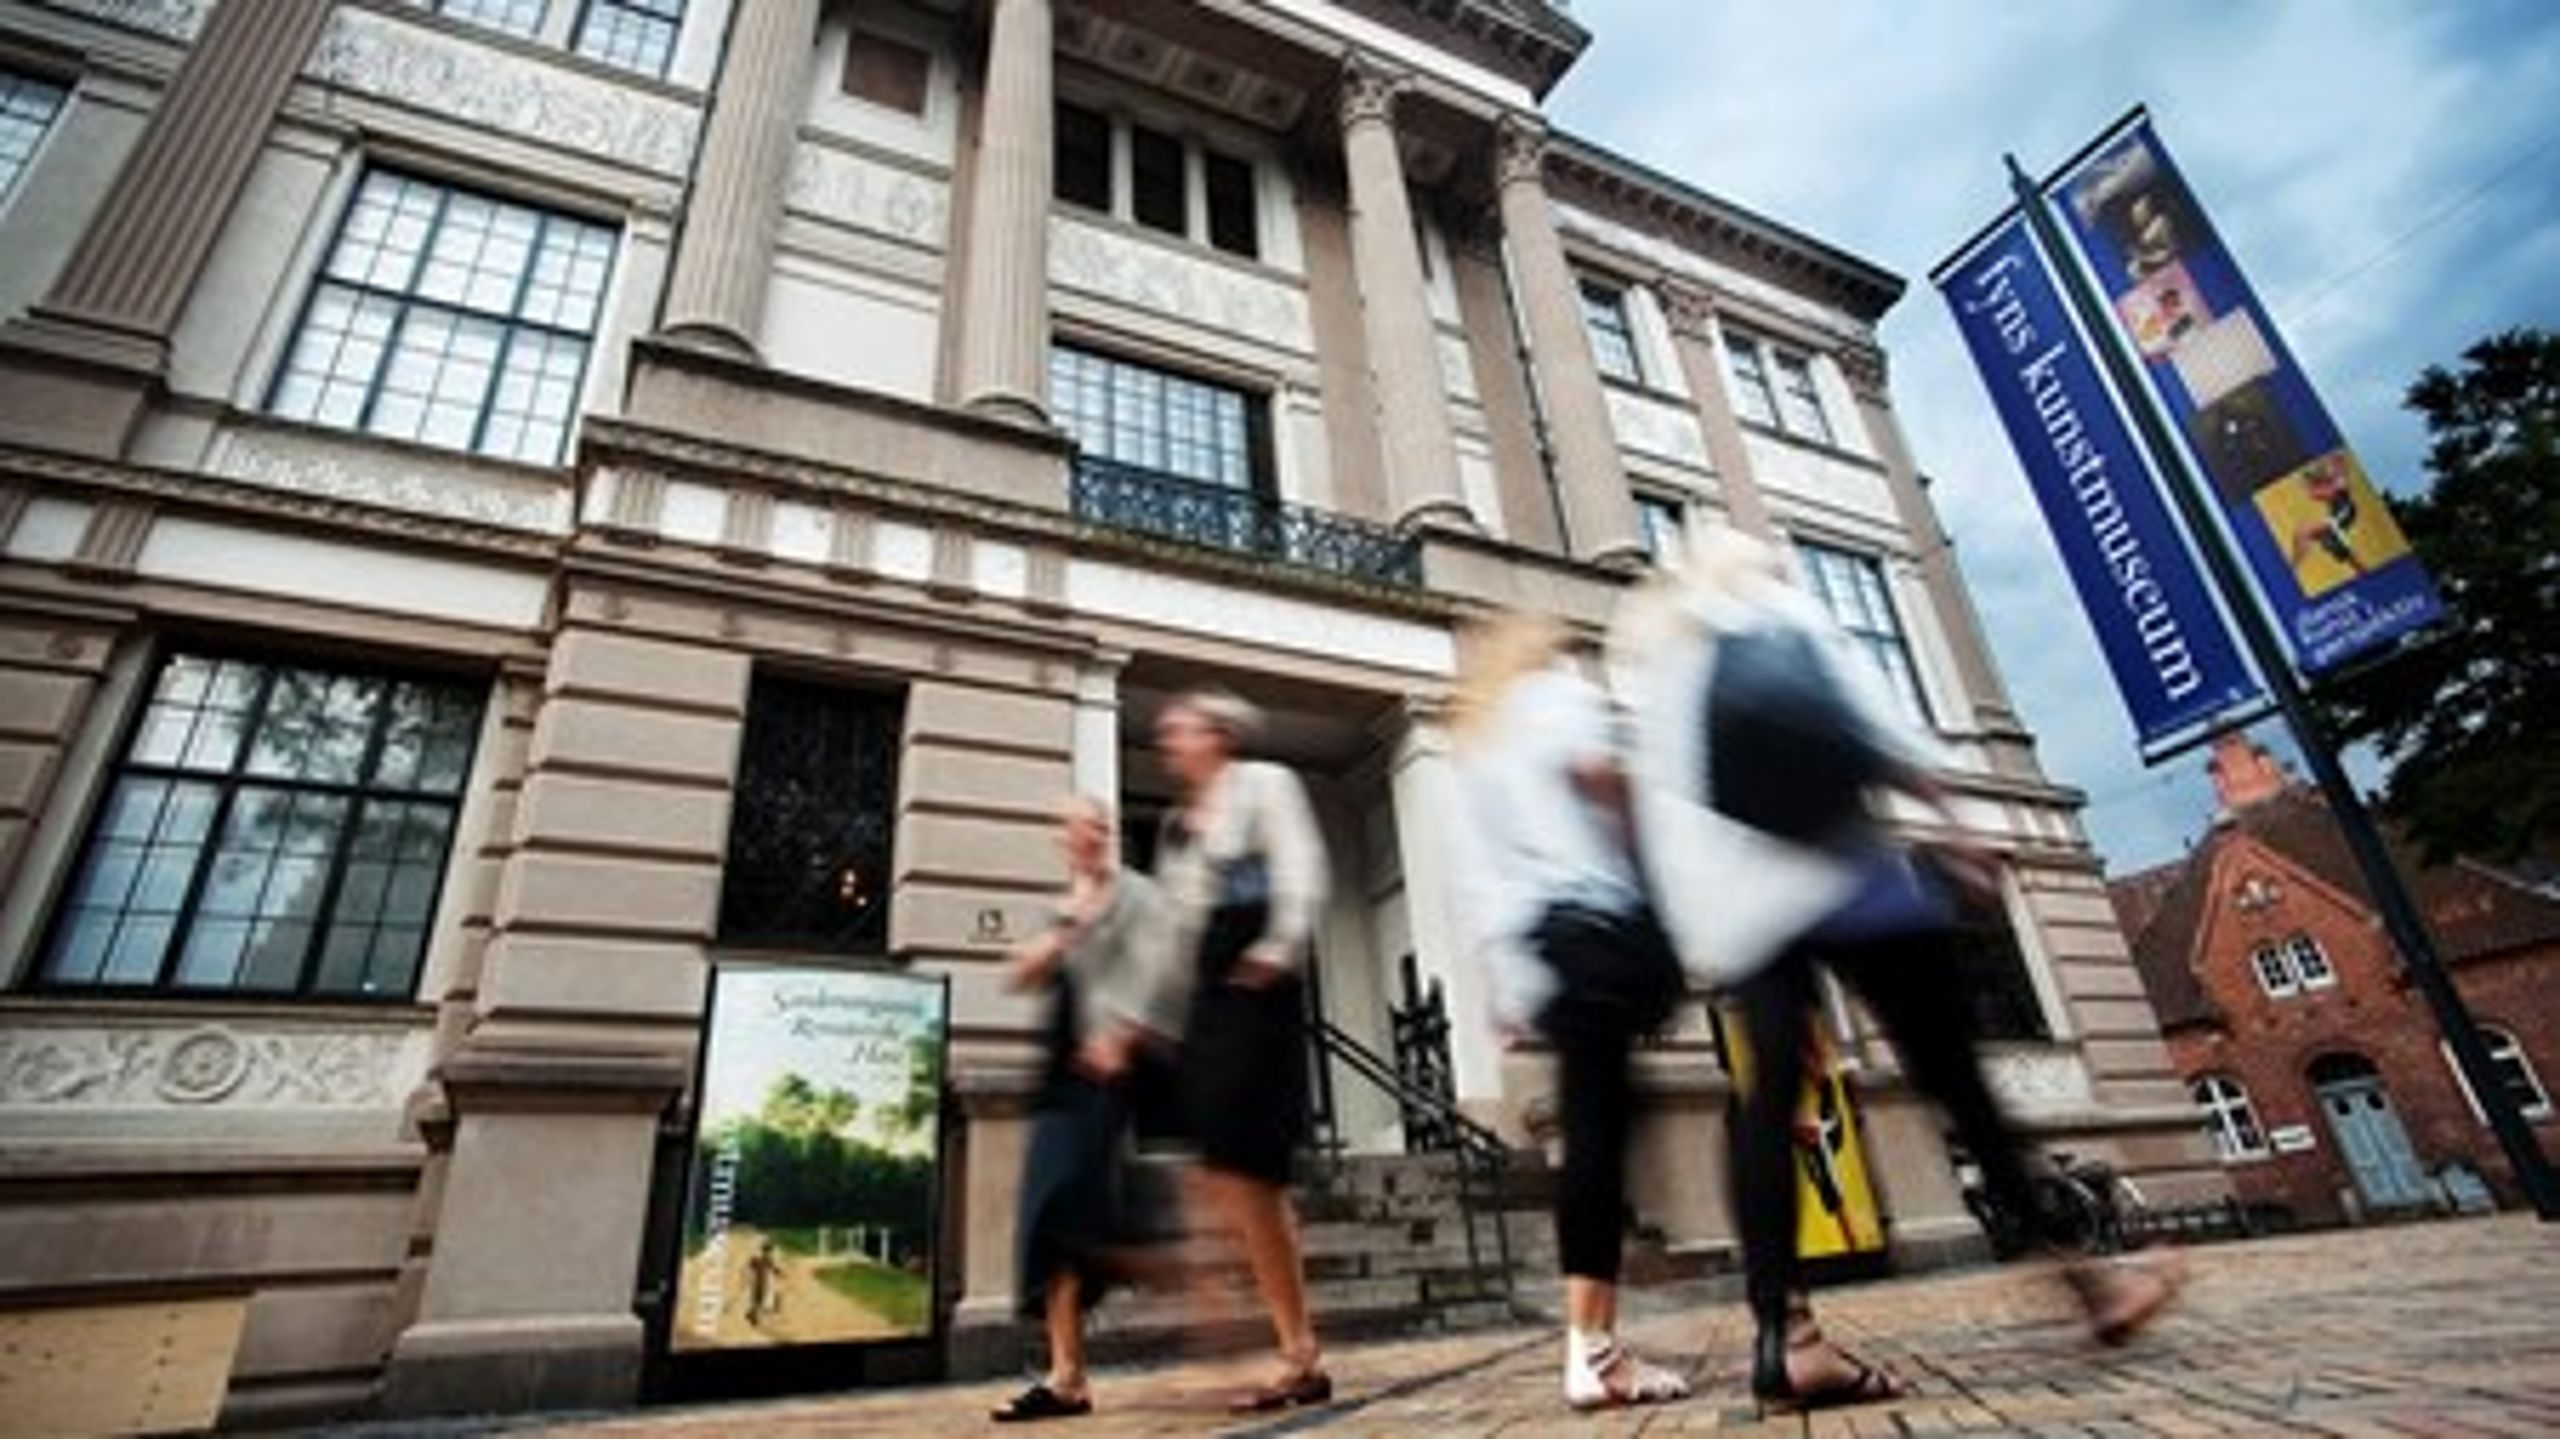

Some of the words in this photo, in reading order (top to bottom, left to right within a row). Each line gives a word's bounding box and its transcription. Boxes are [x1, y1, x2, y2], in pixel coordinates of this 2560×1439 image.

[1963, 255, 2037, 355] fyns
[2018, 340, 2202, 701] kunstmuseum
[977, 908, 1006, 937] 13
